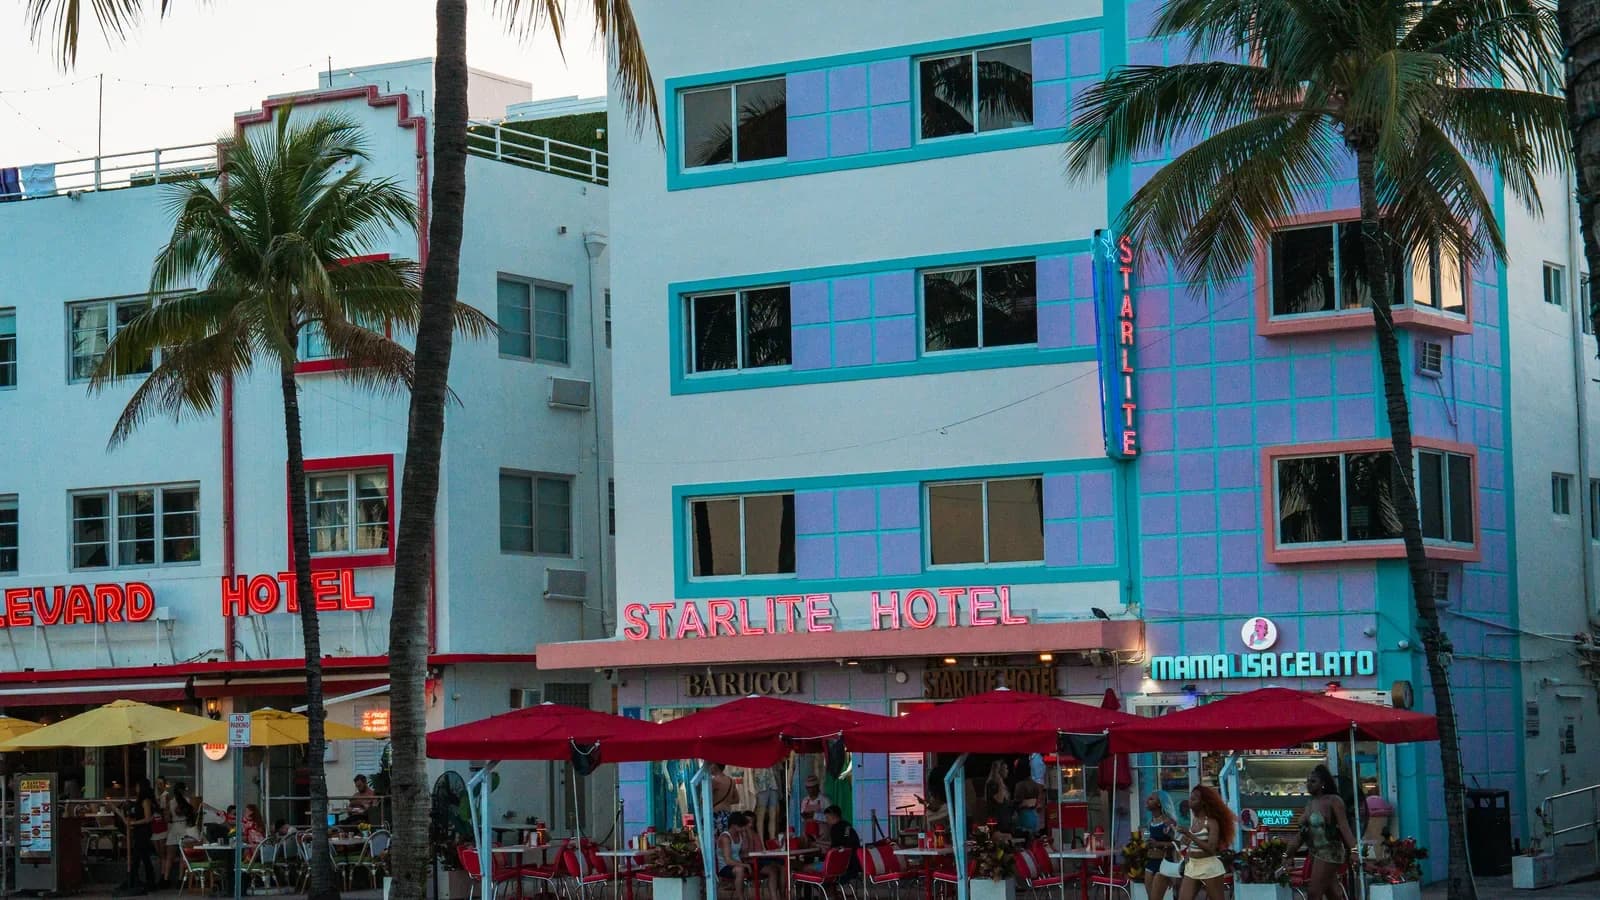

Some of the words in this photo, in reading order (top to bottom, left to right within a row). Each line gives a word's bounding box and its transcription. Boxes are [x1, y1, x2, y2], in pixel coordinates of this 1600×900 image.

[1119, 235, 1137, 455] STARLITE
[0, 581, 155, 628] EVARD
[222, 568, 375, 617] HOTEL
[624, 594, 833, 641] STARLITE
[871, 586, 1028, 631] HOTEL
[685, 671, 802, 697] BARUCCI
[1280, 650, 1375, 677] GELATO
[1262, 817, 1289, 825] GELATO
